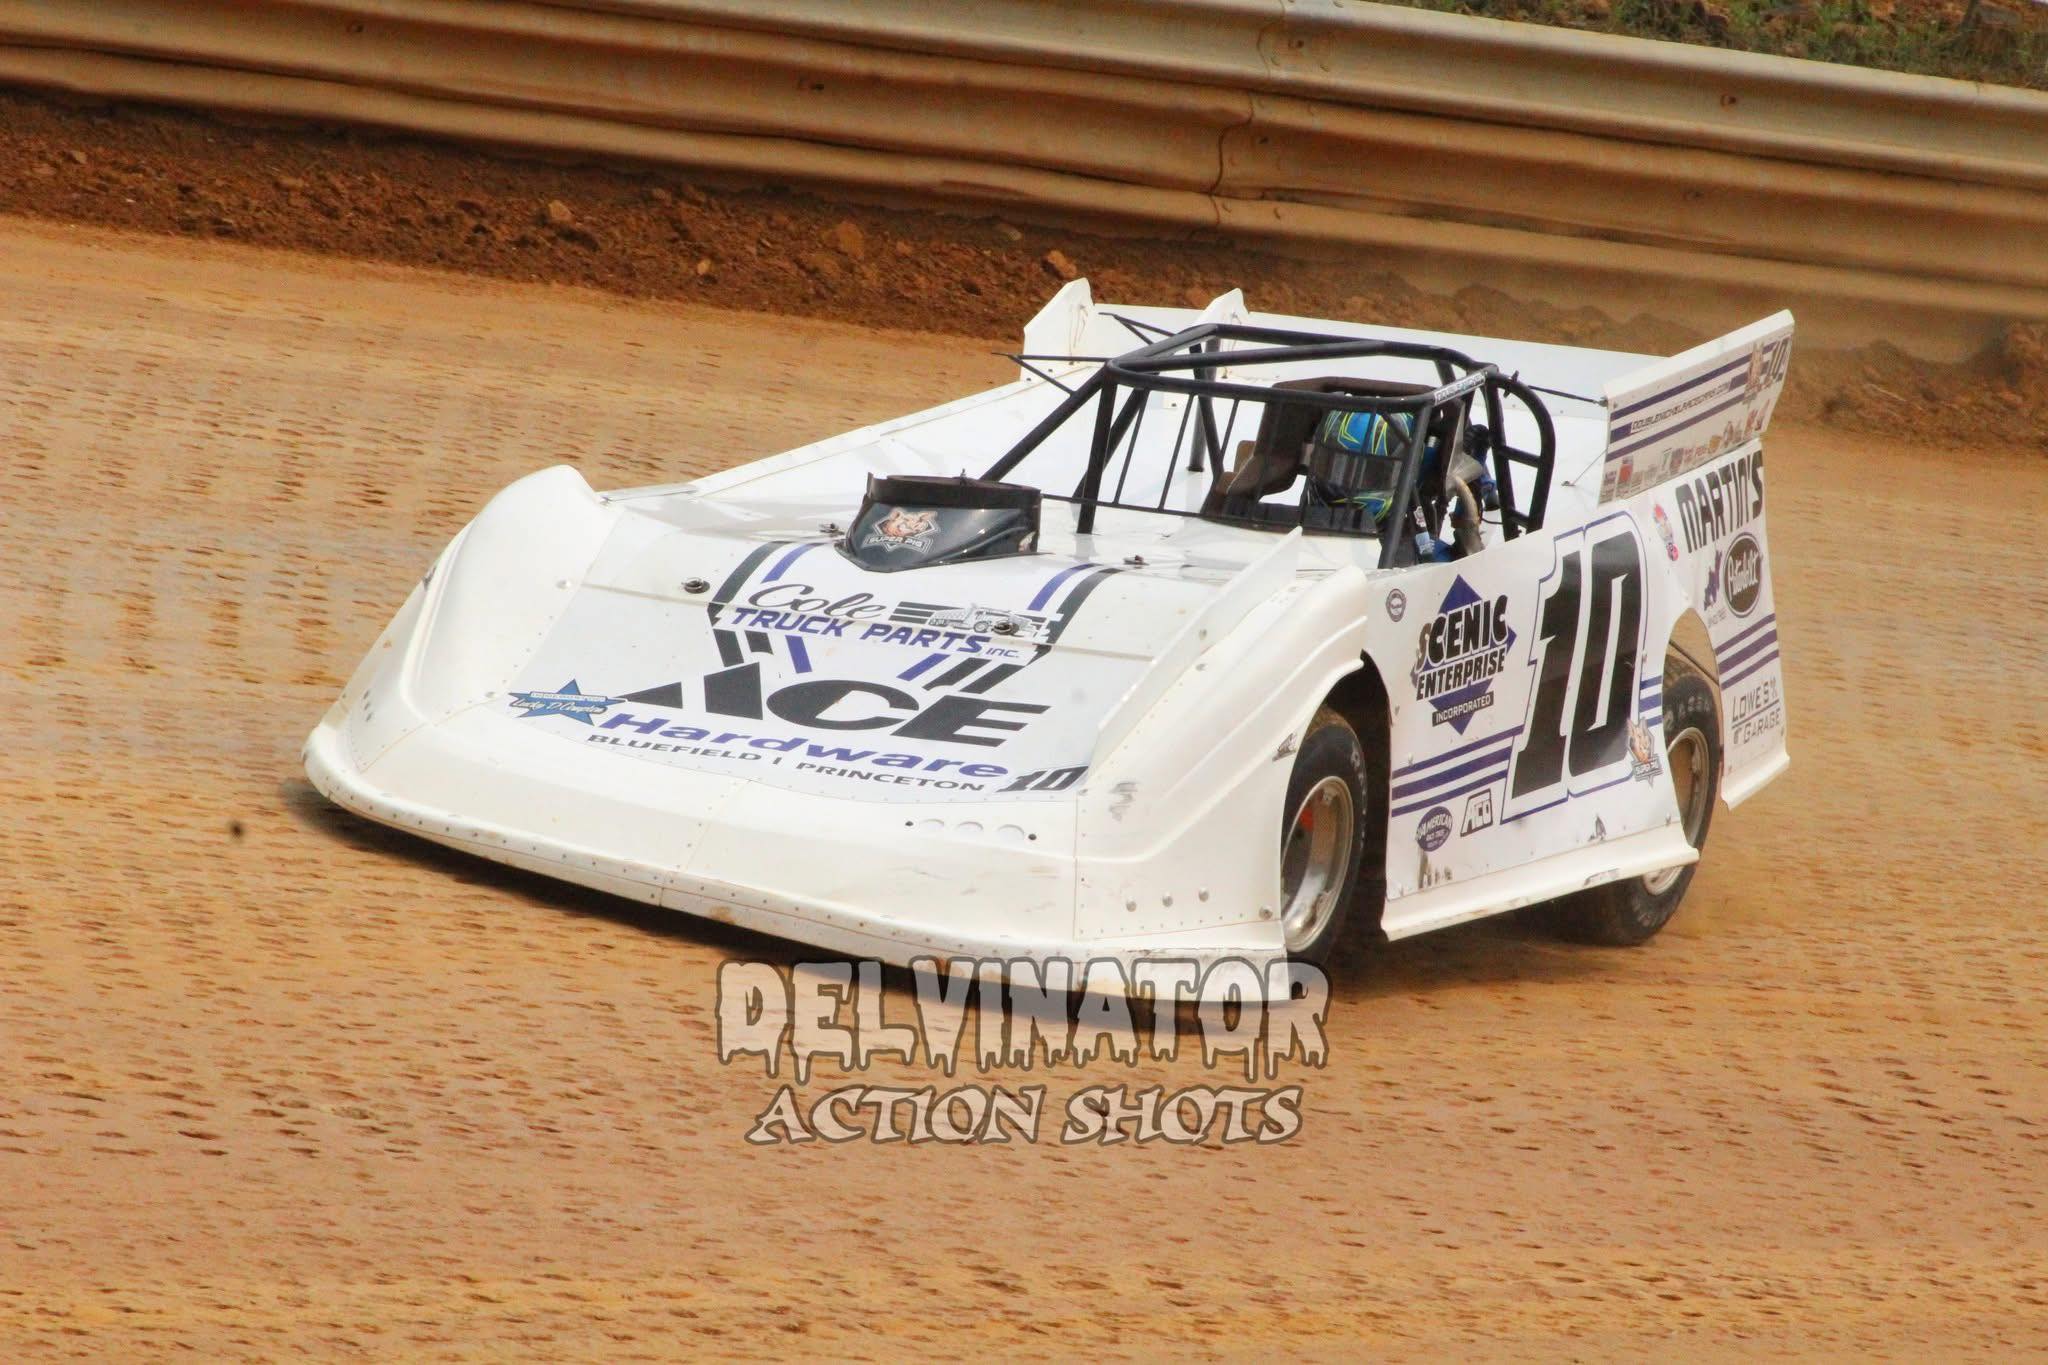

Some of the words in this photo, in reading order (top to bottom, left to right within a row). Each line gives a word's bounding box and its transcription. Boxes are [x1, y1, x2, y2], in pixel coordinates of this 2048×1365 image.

[1675, 450, 1764, 554] MARTIN'S
[748, 584, 887, 620] Cole
[731, 607, 854, 637] TRUCK
[859, 623, 992, 654] PARTS
[1415, 595, 1508, 672] SCENIC
[1416, 646, 1506, 701] ENTERPRISE
[1511, 530, 1642, 800] 10
[1435, 694, 1491, 724] INCORPORATED
[1744, 707, 1781, 745] GARAGE
[587, 734, 762, 761] BLUEFIELD
[796, 762, 985, 791] PRINCETON
[598, 713, 1009, 778] Hardware
[995, 766, 1090, 793] 10
